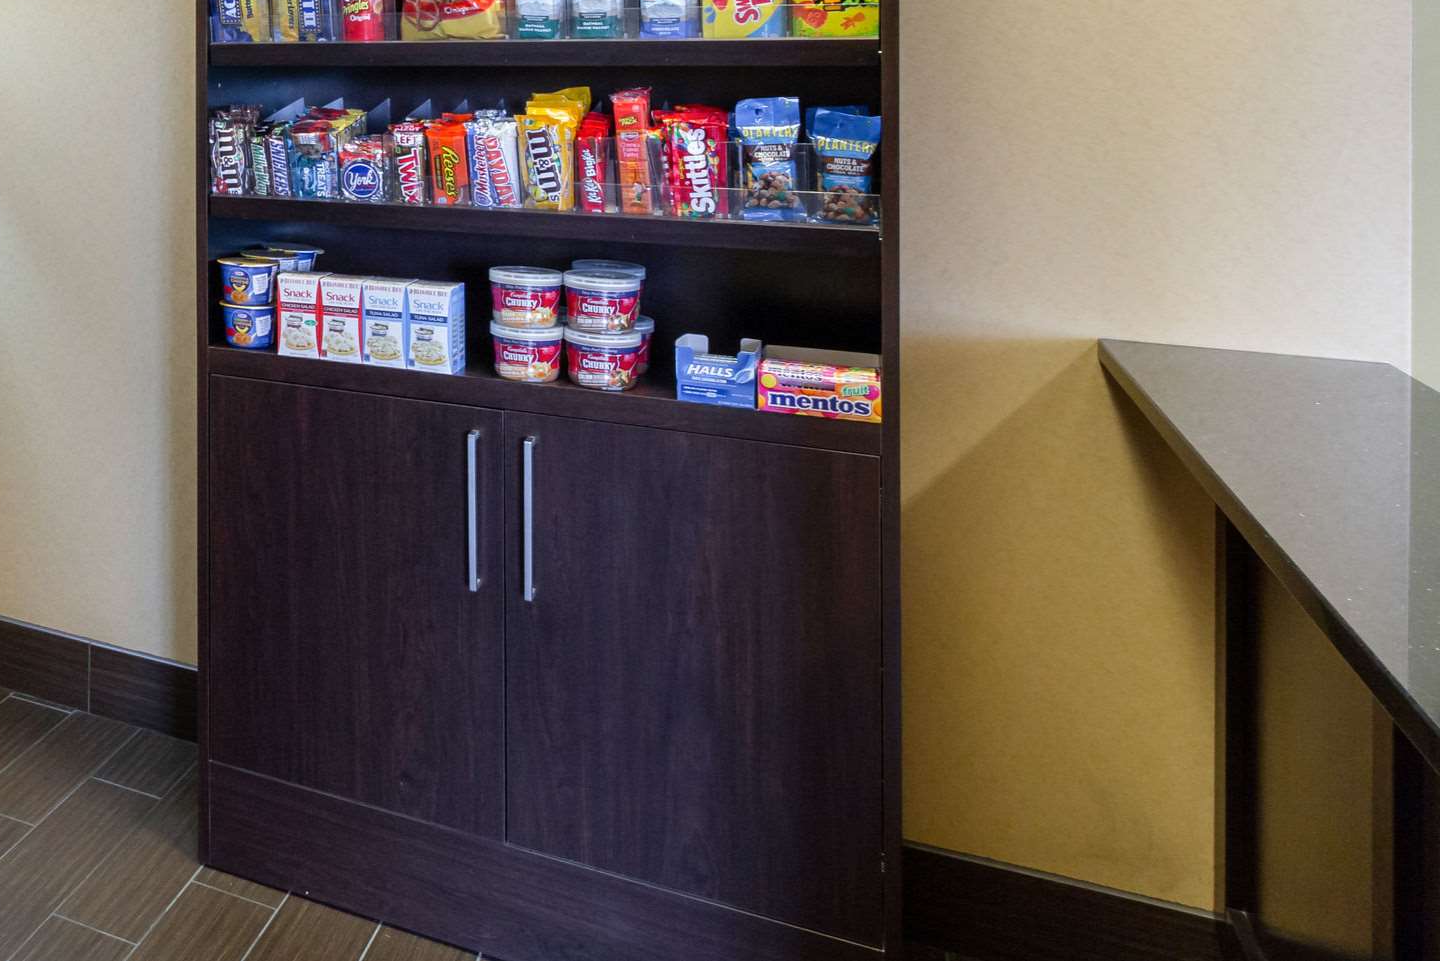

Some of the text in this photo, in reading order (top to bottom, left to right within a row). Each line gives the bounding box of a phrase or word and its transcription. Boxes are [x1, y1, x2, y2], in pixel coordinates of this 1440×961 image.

[834, 157, 851, 165] NUTS
[269, 141, 290, 196] SNICKERS
[826, 163, 866, 173] CHOCOLATE
[349, 170, 377, 192] York
[283, 287, 313, 298] Snack
[326, 291, 356, 302] Snack
[367, 295, 399, 307] Snack
[412, 299, 445, 311] Snack
[686, 363, 734, 378] HALLS
[842, 385, 870, 397] fruit
[768, 391, 872, 415] mentos
